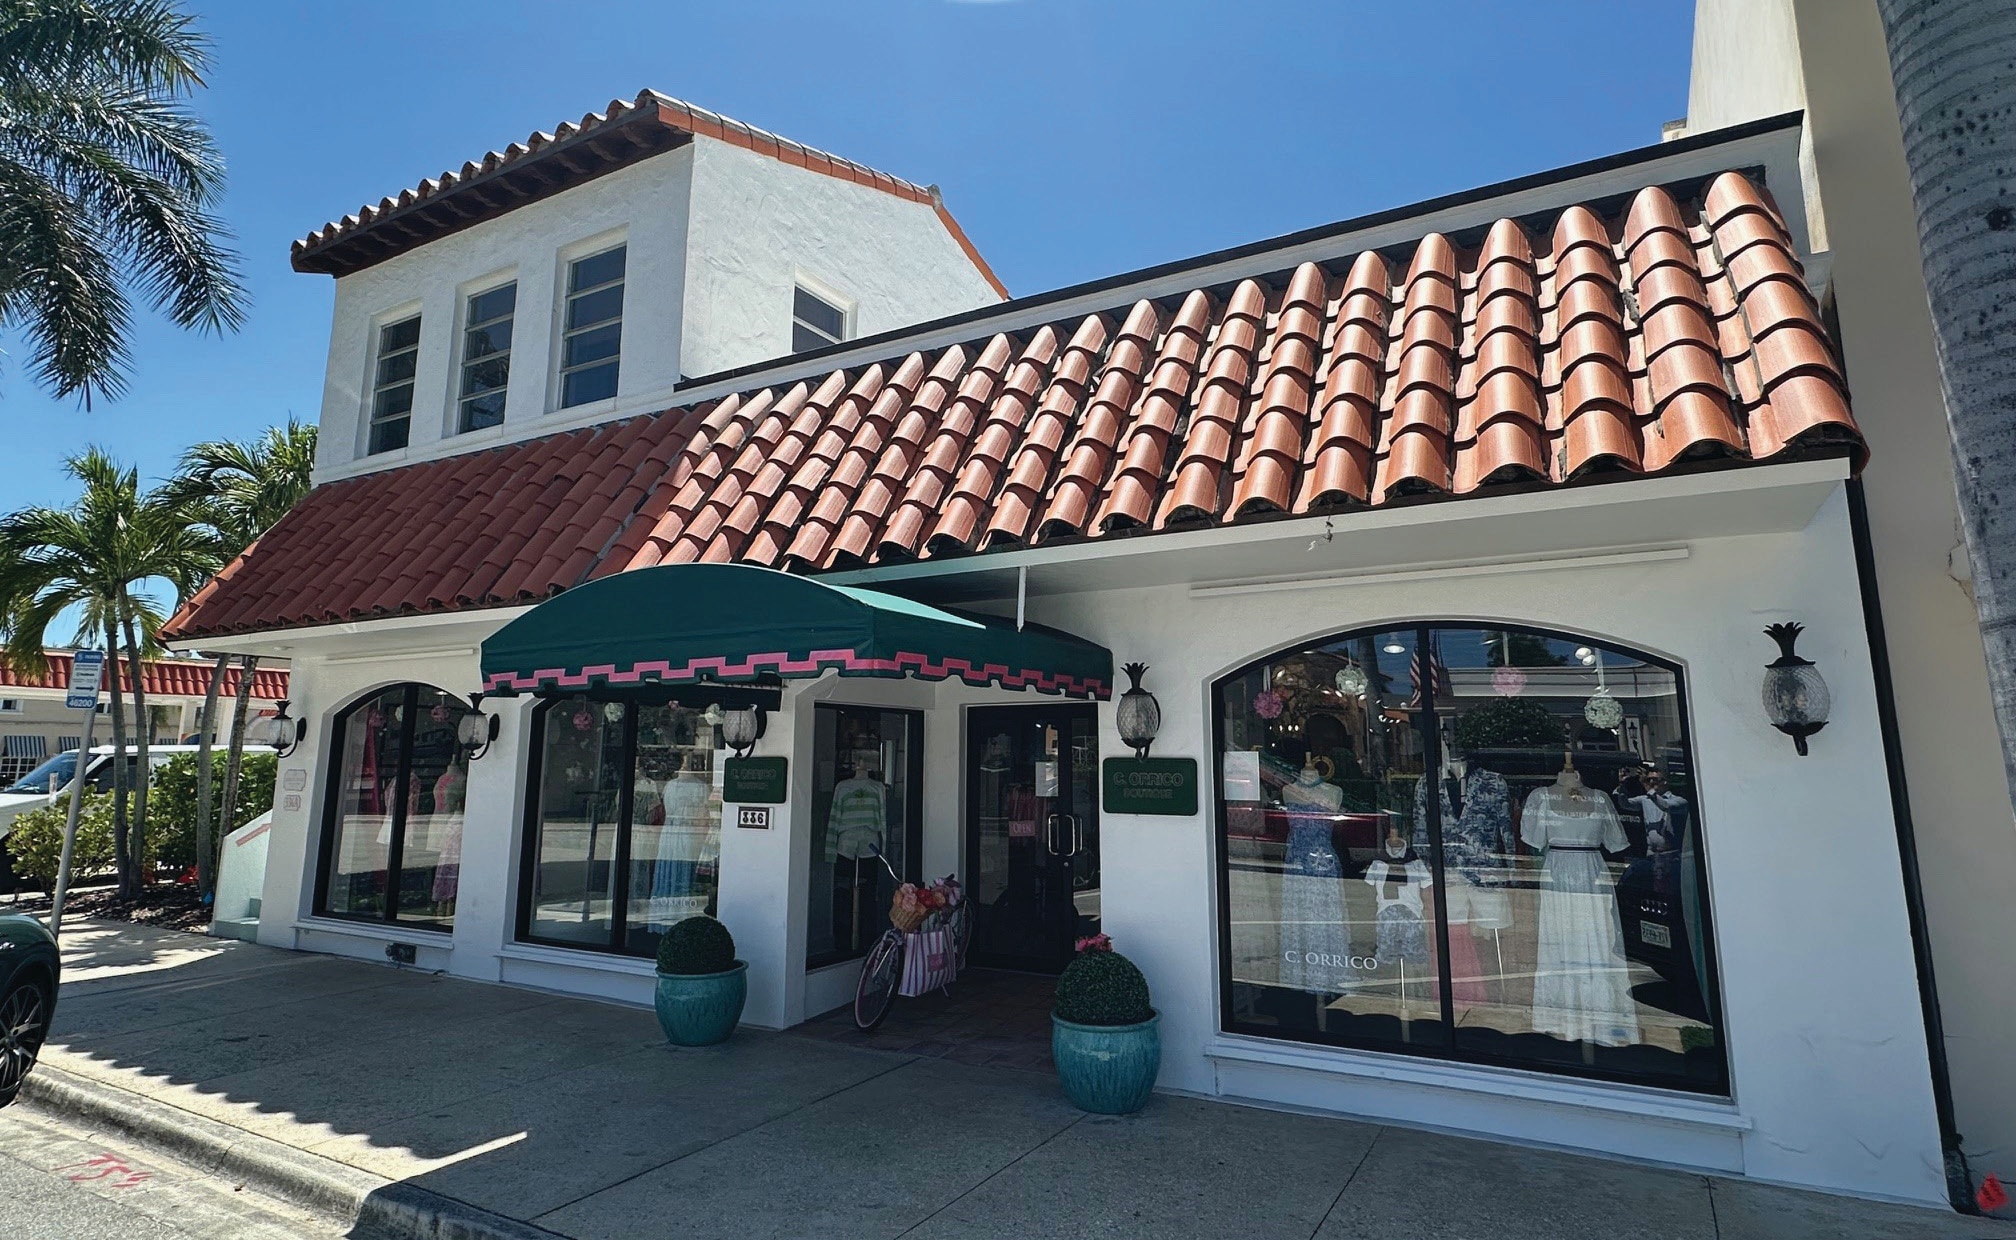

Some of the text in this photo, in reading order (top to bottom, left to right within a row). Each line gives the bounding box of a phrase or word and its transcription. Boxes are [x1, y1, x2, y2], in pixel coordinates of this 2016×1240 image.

[69, 699, 93, 707] 46200
[1128, 772, 1184, 787] ORRICO
[742, 811, 764, 824] 336
[1013, 823, 1031, 833] OPEN
[1284, 950, 1378, 970] C. ORRICO
